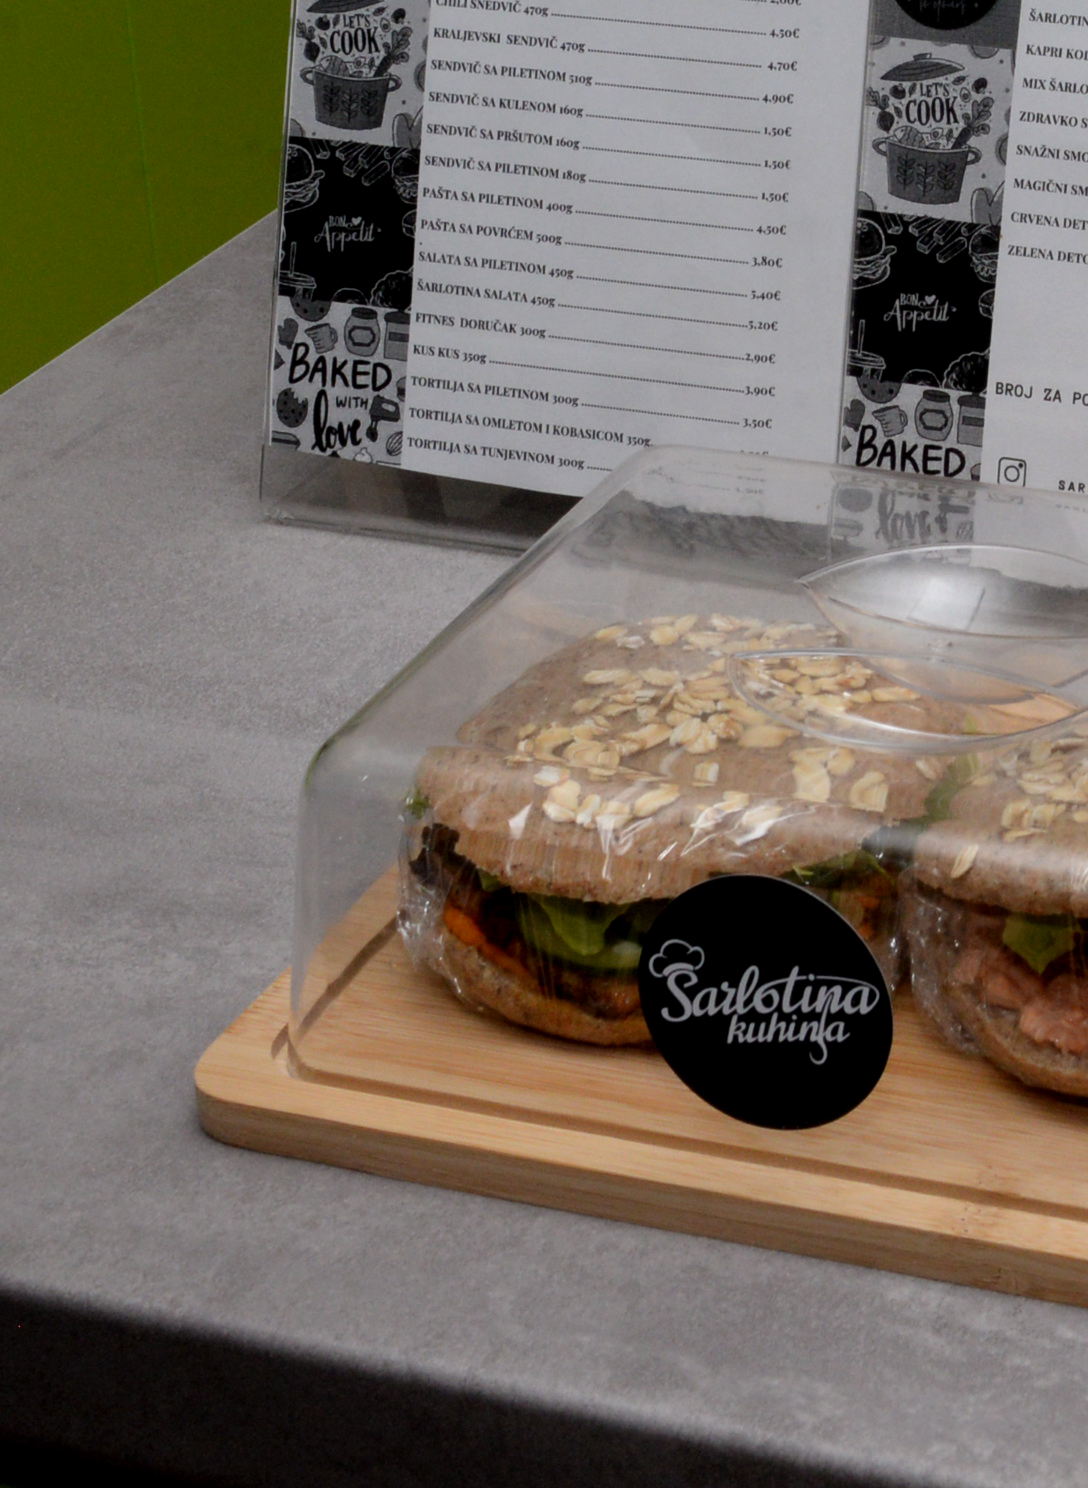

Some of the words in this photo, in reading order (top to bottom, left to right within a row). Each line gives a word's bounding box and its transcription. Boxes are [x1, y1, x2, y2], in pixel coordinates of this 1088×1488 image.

[522, 5, 550, 18] 470g
[330, 28, 379, 55] COOK
[433, 27, 501, 44] KRALJEVSKI
[506, 34, 558, 49] SENDVIČ
[559, 41, 586, 54] 470g
[1025, 43, 1063, 59] KAPRI
[1022, 77, 1047, 91] MIX
[905, 96, 959, 125] COOK
[1018, 110, 1079, 128] ZDRAVKO
[426, 123, 478, 139] SENDVIČ
[479, 128, 495, 141] SA
[496, 129, 553, 146] PRŠUTOM
[555, 137, 581, 151] 160g
[1015, 144, 1061, 160] SNAŽNI
[1013, 177, 1068, 195] MAGIČNI
[420, 218, 457, 233] PAŠTA
[458, 223, 474, 235] SA
[536, 233, 563, 246] 500g
[1010, 211, 1060, 228] CRVENA
[1007, 244, 1055, 261] ZELENA
[414, 310, 457, 328] FITNES
[459, 317, 517, 335] DORUČAK
[518, 326, 548, 341] 300g
[289, 342, 392, 391] BAKED
[336, 396, 369, 410] WITH
[995, 381, 1034, 399] BROJ
[1043, 387, 1062, 404] ZA
[312, 389, 362, 452] love
[408, 406, 463, 425] TORTILJA
[464, 414, 480, 426] SA
[481, 416, 543, 434] OMLETOM
[545, 423, 550, 435] I
[552, 424, 624, 444] KOBASICOM
[626, 435, 652, 449] 350g
[856, 424, 966, 477] BAKED
[726, 1012, 850, 1066] kuhinja
